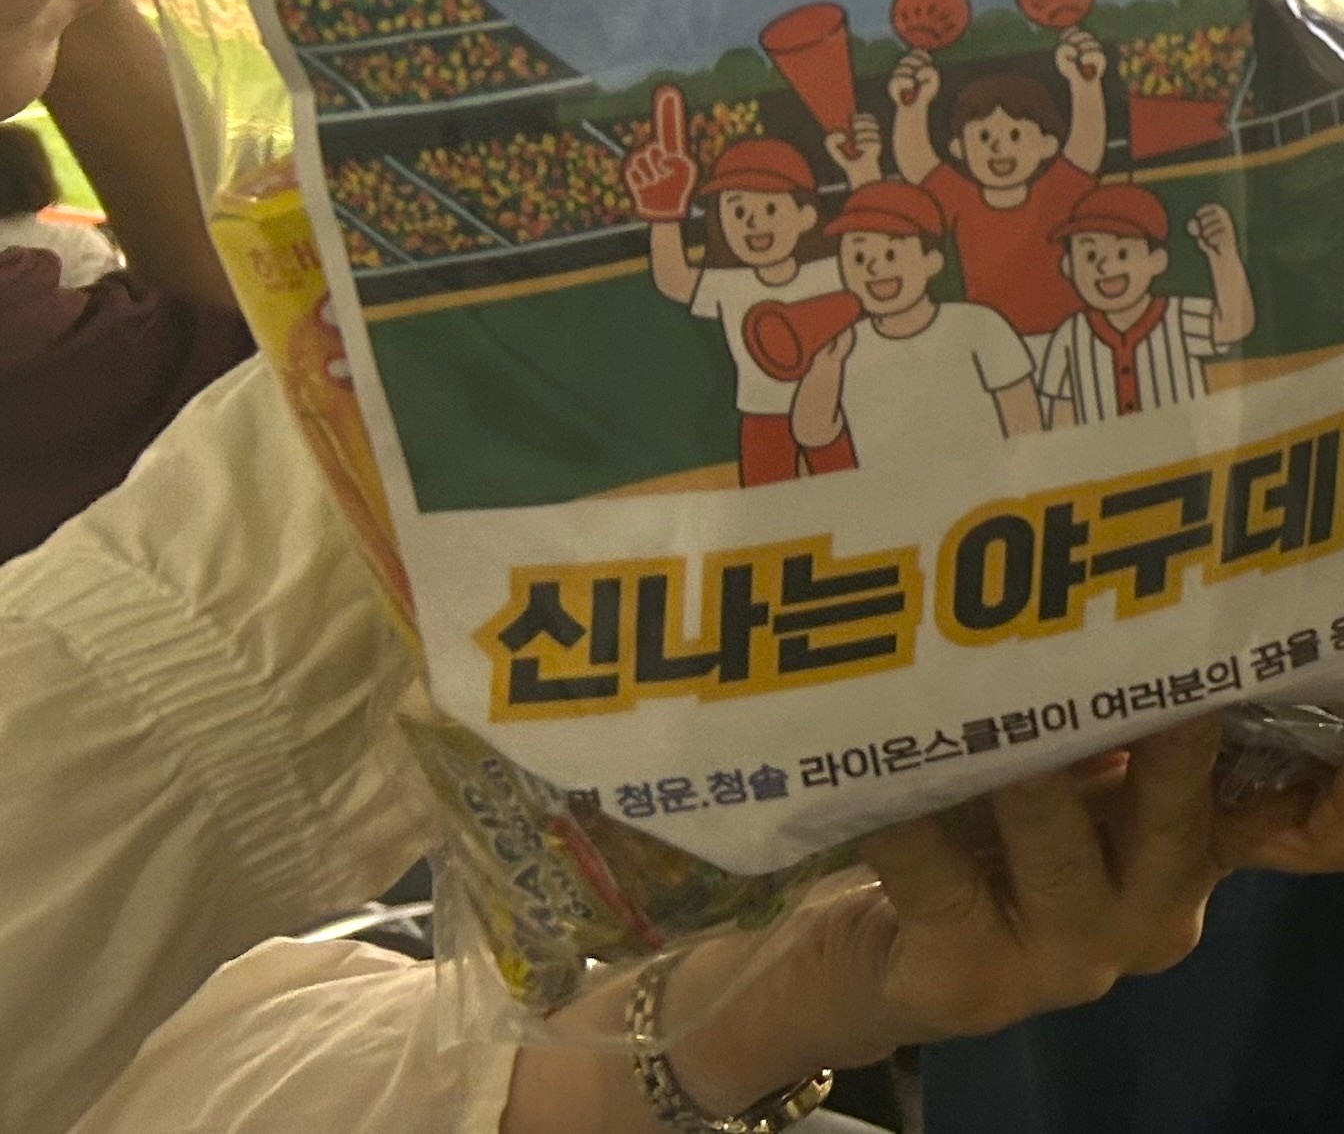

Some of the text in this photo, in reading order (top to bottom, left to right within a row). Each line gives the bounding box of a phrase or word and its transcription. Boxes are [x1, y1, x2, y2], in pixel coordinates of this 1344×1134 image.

[499, 556, 905, 704] 신나는
[799, 699, 1079, 791] 라이온스클럽이
[1091, 655, 1242, 722] 여러분의
[1250, 627, 1321, 682] 꿈을
